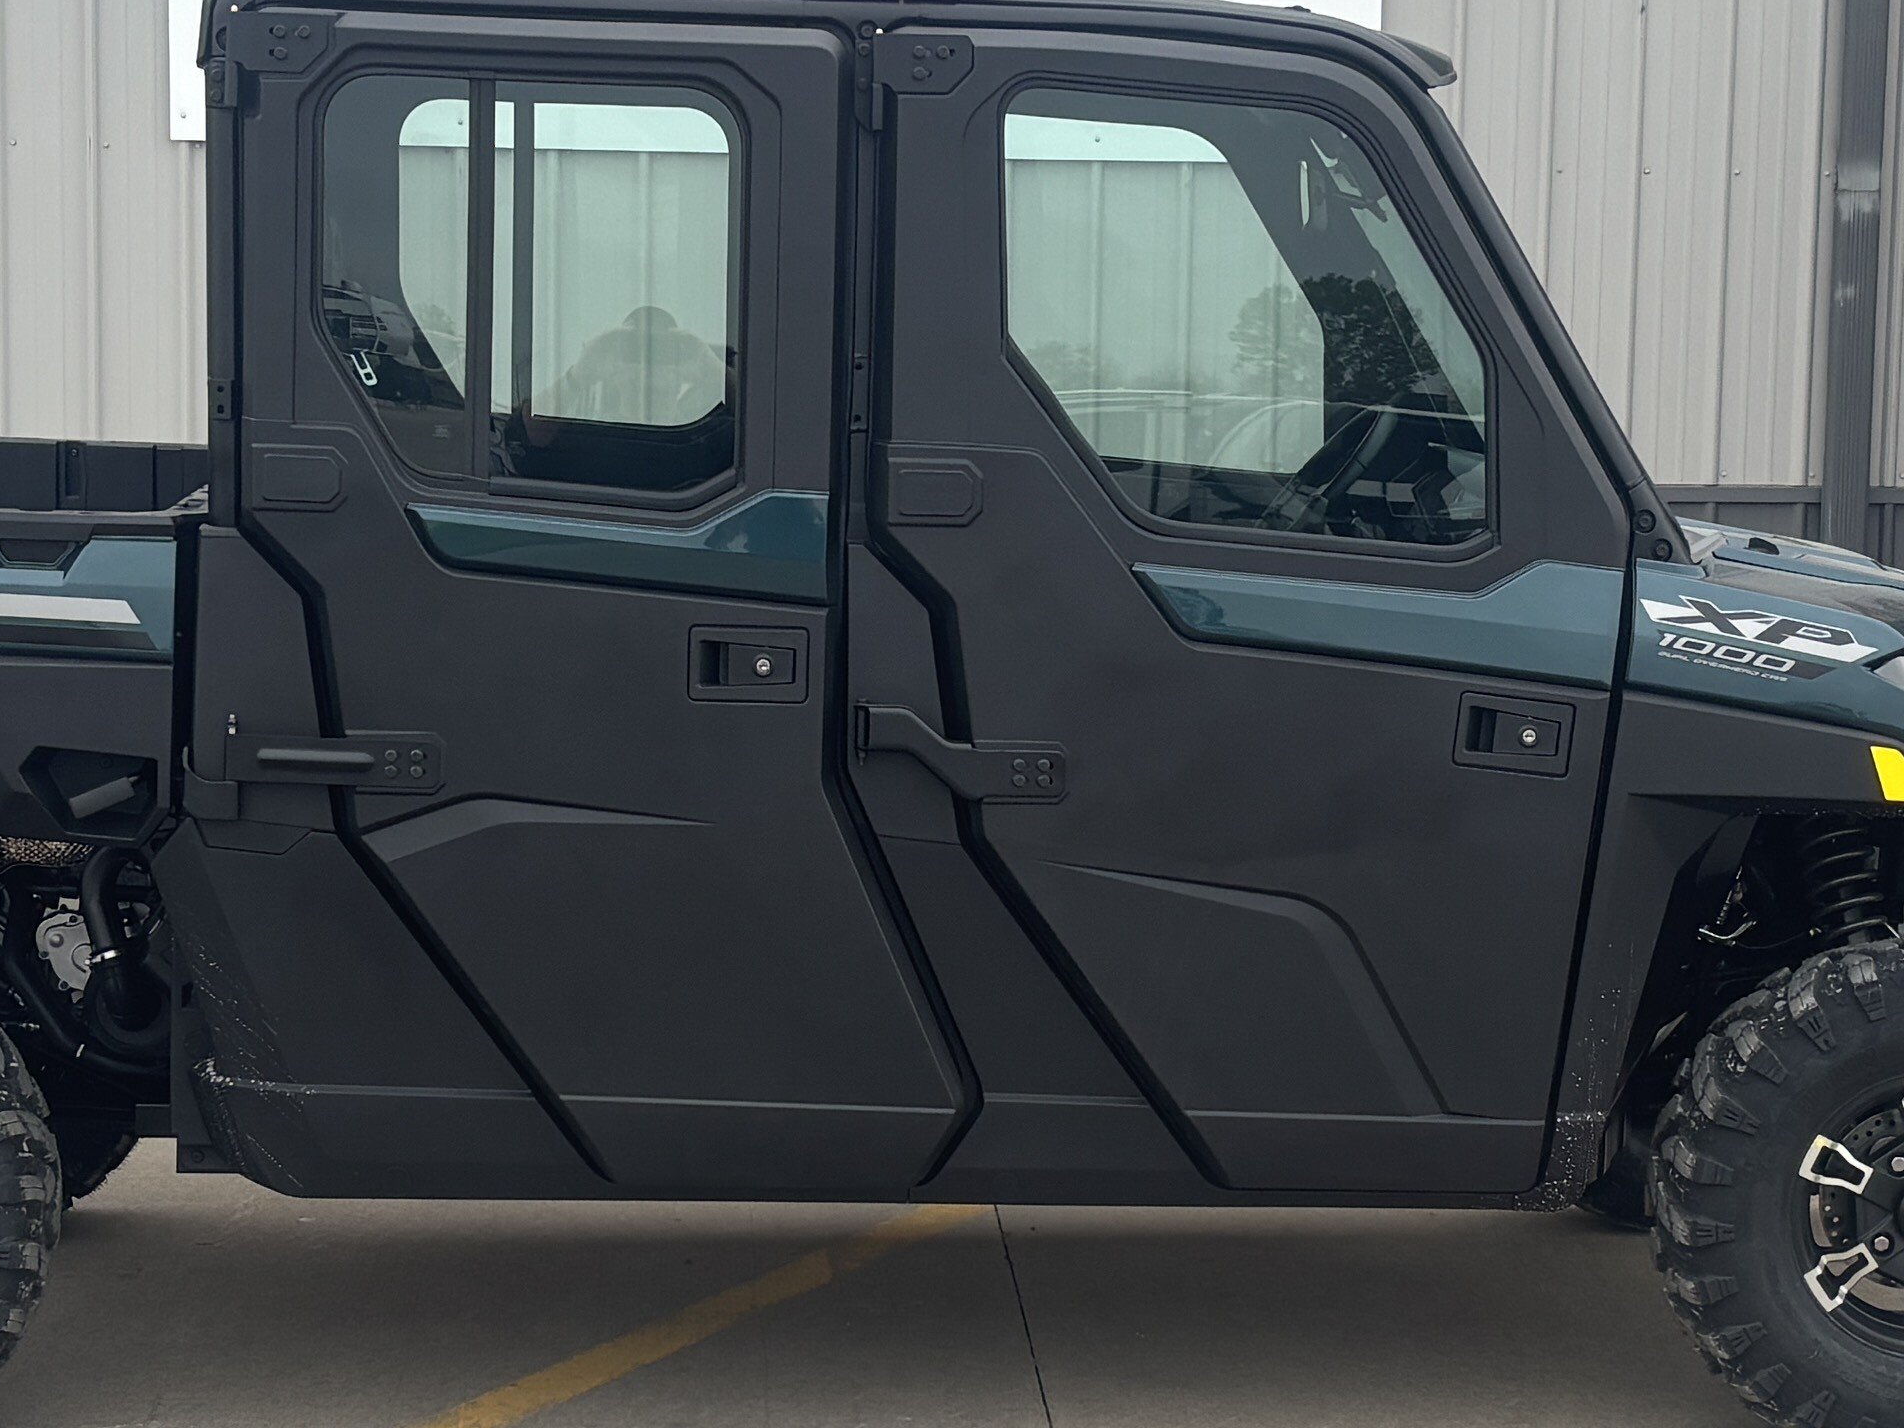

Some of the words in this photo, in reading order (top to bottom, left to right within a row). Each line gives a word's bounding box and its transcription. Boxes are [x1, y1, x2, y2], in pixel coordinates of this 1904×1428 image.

[1653, 594, 1860, 646] XP
[1657, 651, 1690, 662] DUAL
[1693, 658, 1760, 676] OVERHEAD
[1658, 632, 1797, 673] 1000
